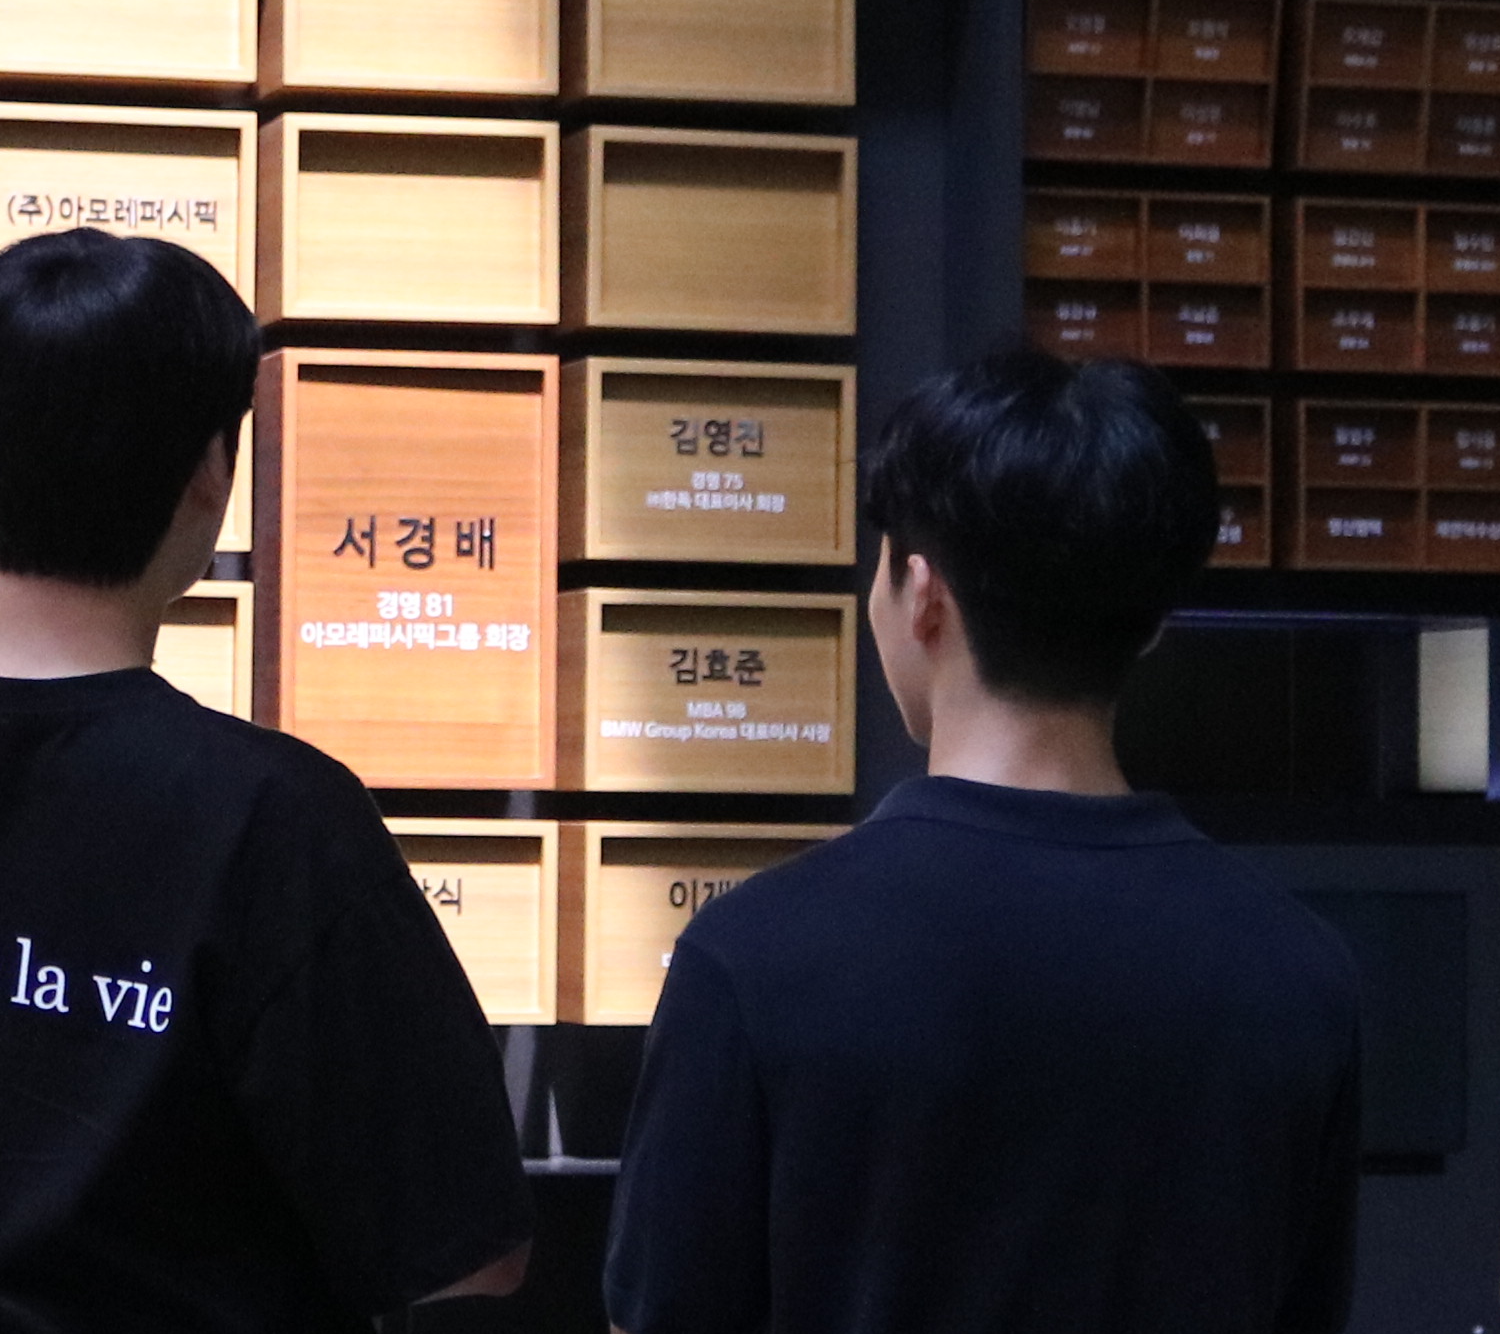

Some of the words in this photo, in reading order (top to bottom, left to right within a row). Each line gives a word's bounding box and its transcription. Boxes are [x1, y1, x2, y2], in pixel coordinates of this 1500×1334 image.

[669, 417, 765, 458] 김영진
[690, 471, 721, 492] 경영
[722, 472, 745, 491] 75
[693, 491, 754, 512] 대표이사
[755, 493, 787, 514] 회장
[375, 590, 422, 620] 경영
[424, 592, 454, 618] 81
[300, 621, 481, 652] 아모레퍼시픽그룹
[483, 623, 531, 654] 회장
[668, 646, 767, 687] 김효준
[686, 700, 724, 719] MBA
[599, 718, 643, 739] BMW
[643, 721, 693, 744] Group
[693, 723, 738, 740] Korea
[739, 722, 799, 742] 대표이사
[801, 723, 832, 745] 사장
[10, 936, 70, 1014] la
[92, 960, 173, 1033] vie
